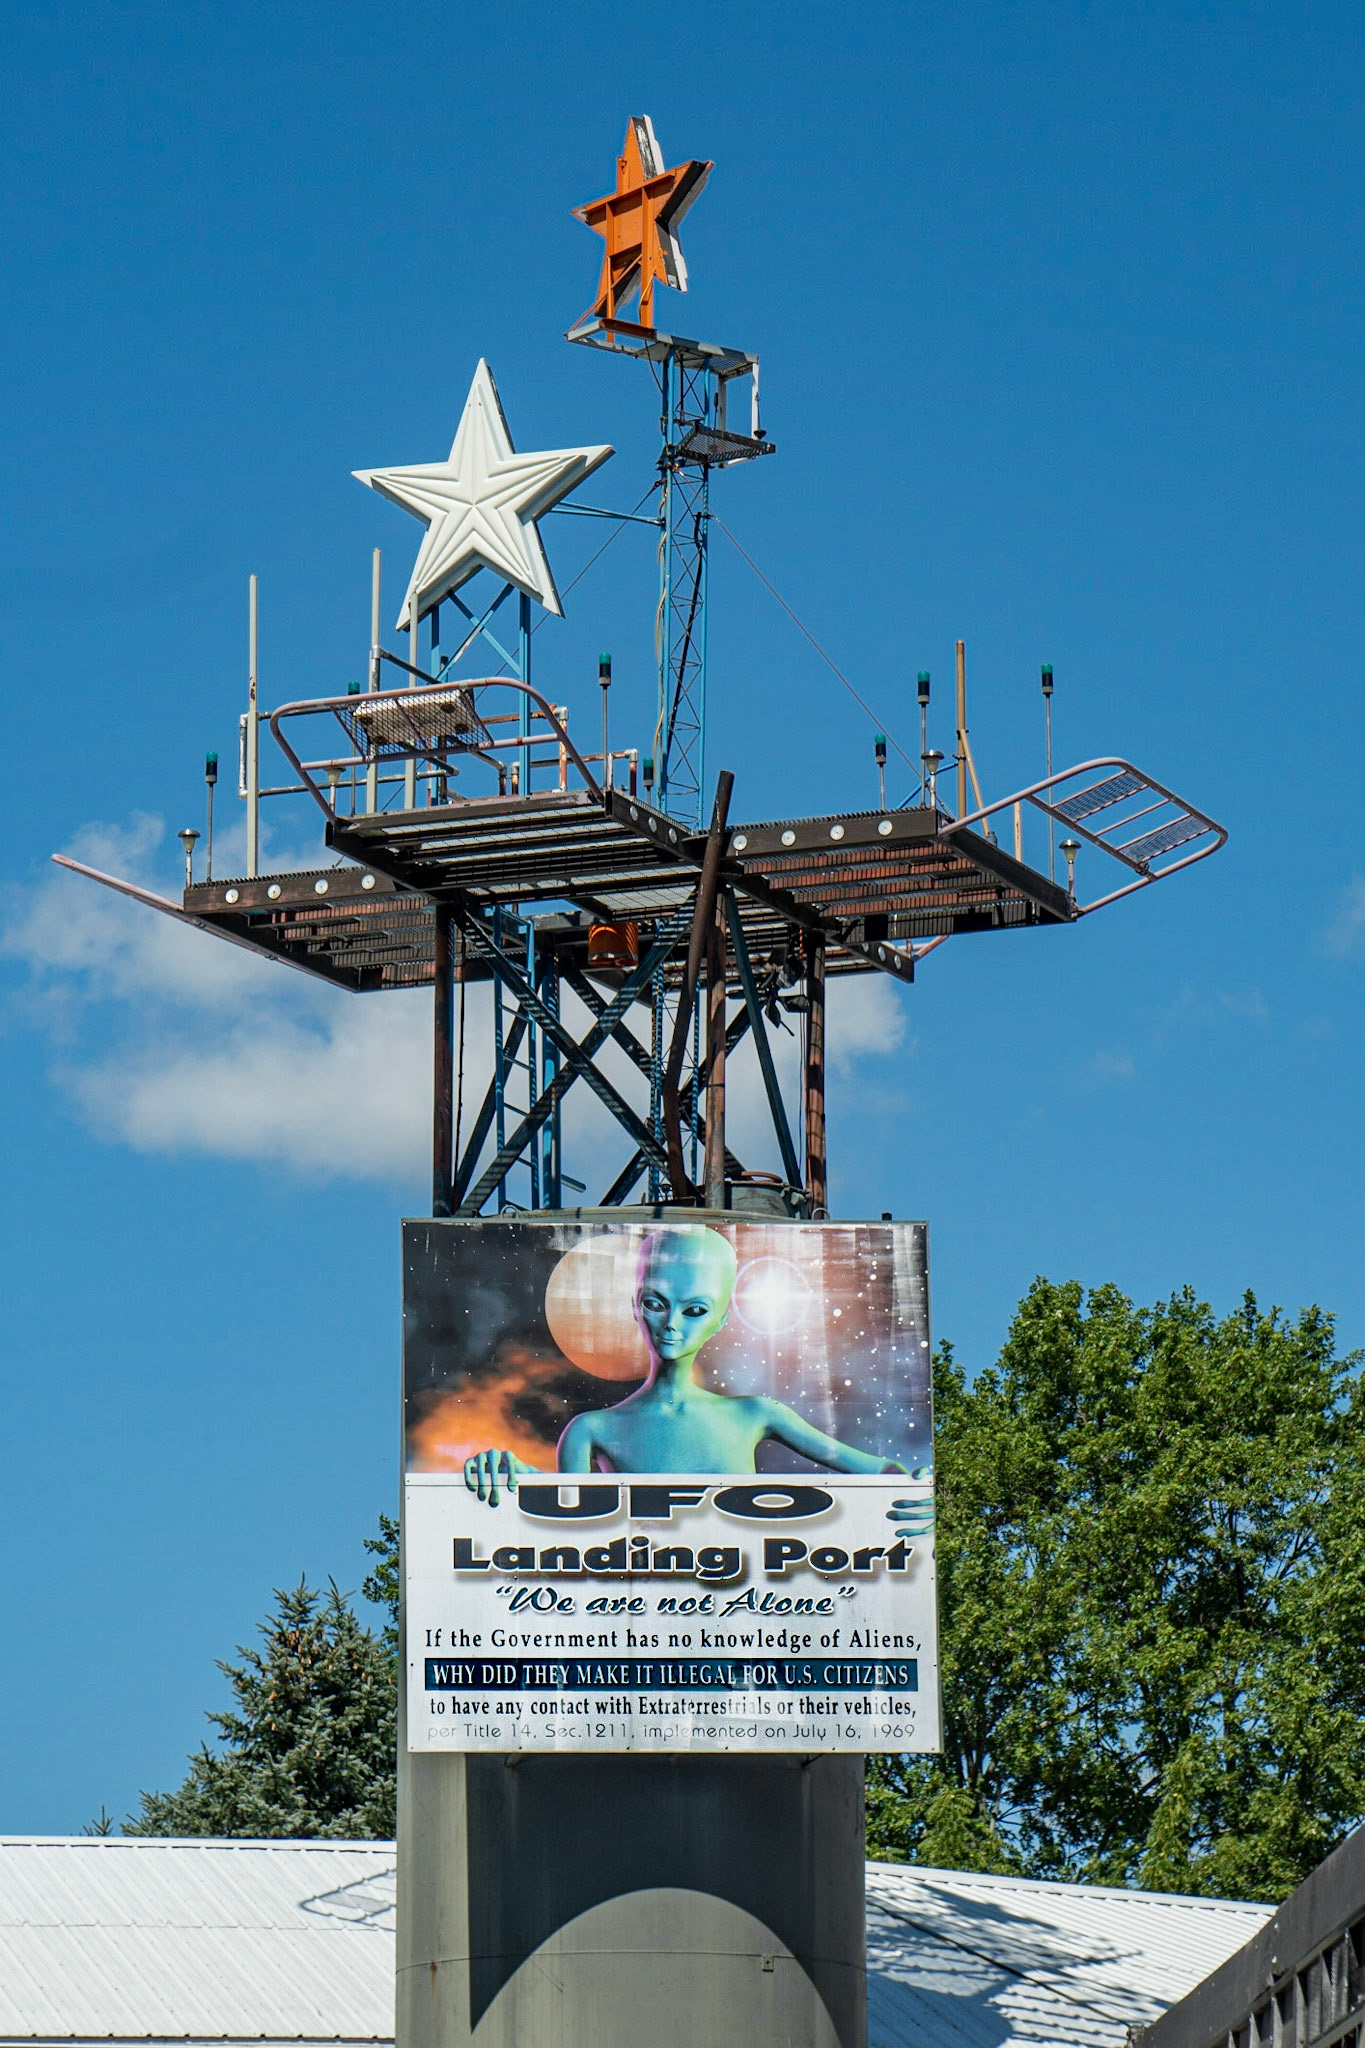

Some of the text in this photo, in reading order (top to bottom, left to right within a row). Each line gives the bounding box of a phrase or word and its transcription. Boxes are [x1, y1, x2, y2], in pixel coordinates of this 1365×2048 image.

[517, 1484, 835, 1519] UFO
[453, 1536, 914, 1579] Landing Port
[587, 1598, 644, 1612] are
[659, 1595, 711, 1612] not
[425, 1629, 921, 1653] If the Government has no knowledge of Aliens,
[433, 1665, 909, 1684] WHY DID THEY MAKE IT ILLEGAL FOR U.S. CITIZENS
[431, 1699, 445, 1714] to
[452, 1696, 489, 1714] have
[496, 1700, 523, 1720] any
[531, 1699, 589, 1714] contact
[596, 1696, 632, 1714] with
[778, 1701, 793, 1715] or
[800, 1697, 839, 1715] their
[846, 1697, 916, 1717] vehicles,
[428, 1726, 456, 1740] per
[464, 1724, 501, 1737] Title
[511, 1724, 537, 1739] 14,
[644, 1724, 757, 1742] implemented
[765, 1726, 786, 1737] on
[793, 1724, 826, 1740] July
[836, 1724, 861, 1739] 16,
[873, 1724, 915, 1737] 1969
